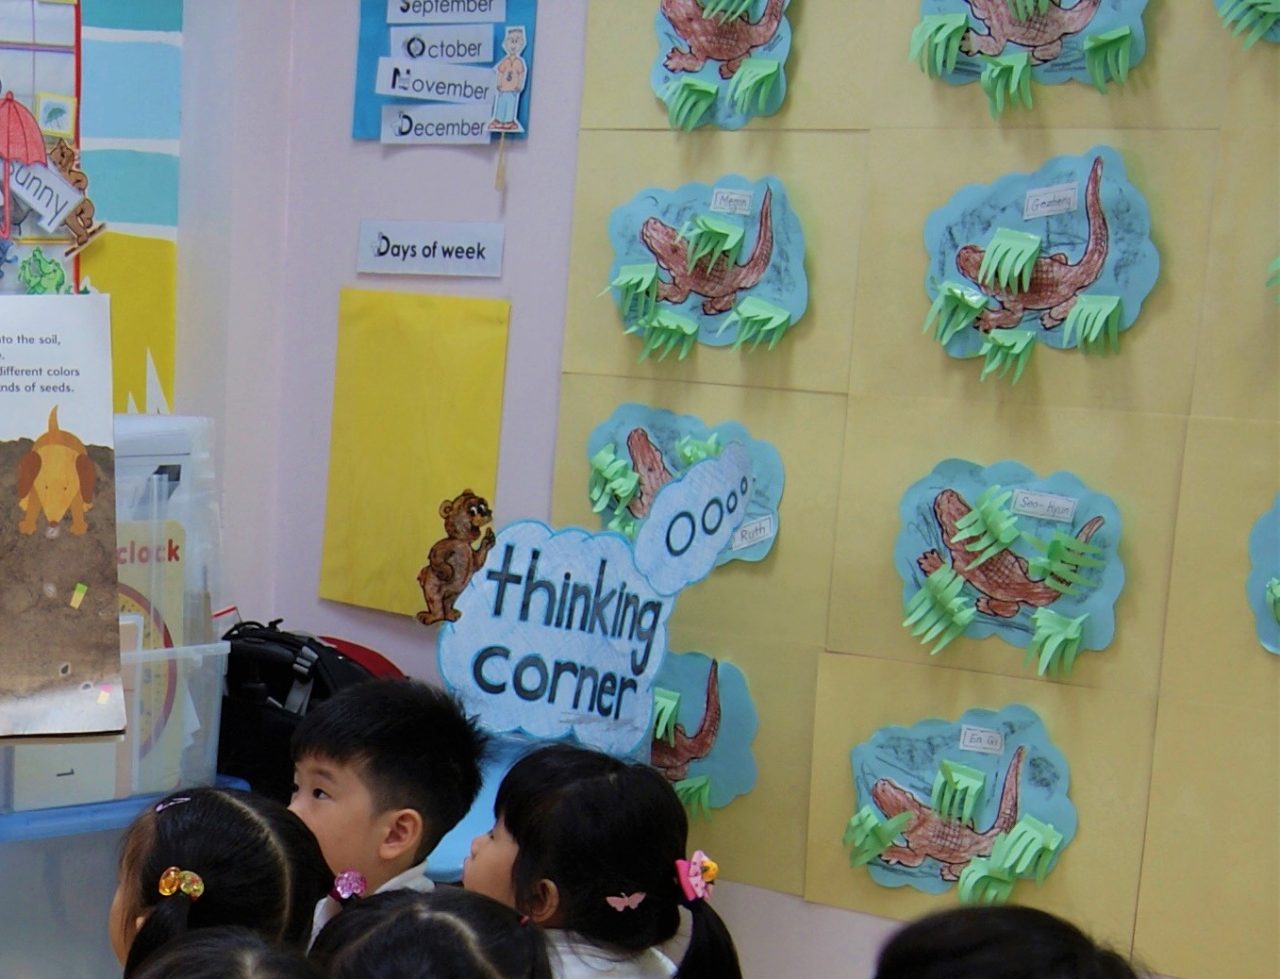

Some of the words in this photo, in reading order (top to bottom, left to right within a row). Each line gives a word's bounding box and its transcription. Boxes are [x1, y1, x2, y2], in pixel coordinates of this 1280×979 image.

[407, 36, 482, 58] October
[391, 67, 489, 100] November
[398, 111, 486, 136] December
[376, 232, 417, 261] Days
[422, 241, 437, 258] of
[441, 243, 486, 260] week
[17, 335, 35, 345] the
[39, 334, 61, 346] soil,
[47, 366, 80, 377] colors
[24, 382, 36, 392] of
[40, 382, 74, 393] seeds.
[117, 539, 180, 565] clock
[487, 544, 663, 675] thinking
[472, 645, 637, 720] corner
